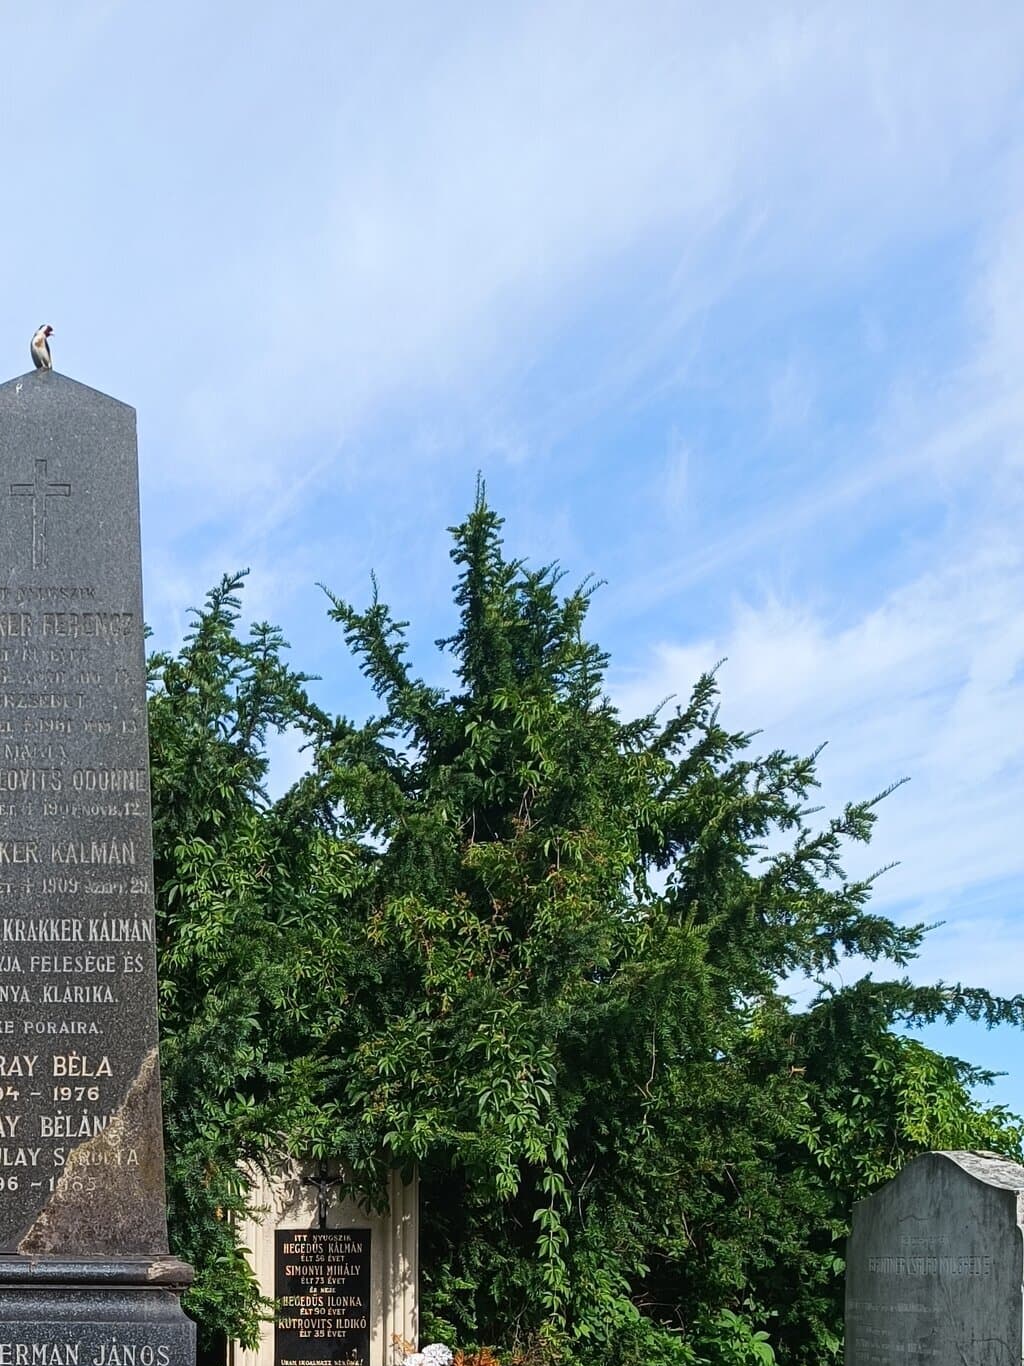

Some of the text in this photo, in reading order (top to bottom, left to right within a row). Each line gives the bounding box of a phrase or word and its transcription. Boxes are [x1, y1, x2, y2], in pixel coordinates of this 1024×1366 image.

[42, 612, 134, 638] FERENCZ
[41, 878, 80, 895] 1909
[2, 918, 84, 942] KRAKKER
[88, 913, 154, 943] KÁLMÁN
[30, 952, 116, 974] FELESÉGE
[123, 951, 144, 974] ÉS
[25, 1020, 104, 1034] PORAIRA.
[53, 1051, 114, 1077] BÉLA
[53, 1085, 99, 1101] 1976
[294, 1234, 352, 1242] ITT NYUGSZIK
[300, 1254, 313, 1262] ÉLT
[328, 1254, 345, 1262] ÉVET
[285, 1263, 361, 1276] SIMONYI MIHÁLY
[300, 1276, 346, 1285] ÉLT 73 ÉVET
[327, 1296, 362, 1307] ILONKA
[300, 1308, 313, 1316] ÉLT
[327, 1308, 346, 1316] ÉVET
[278, 1315, 367, 1329] KUTROVITS ILDIKÓ
[299, 1329, 312, 1337] ÉLT
[327, 1329, 346, 1337] ÉVET
[93, 1337, 170, 1366] JÁNOS
